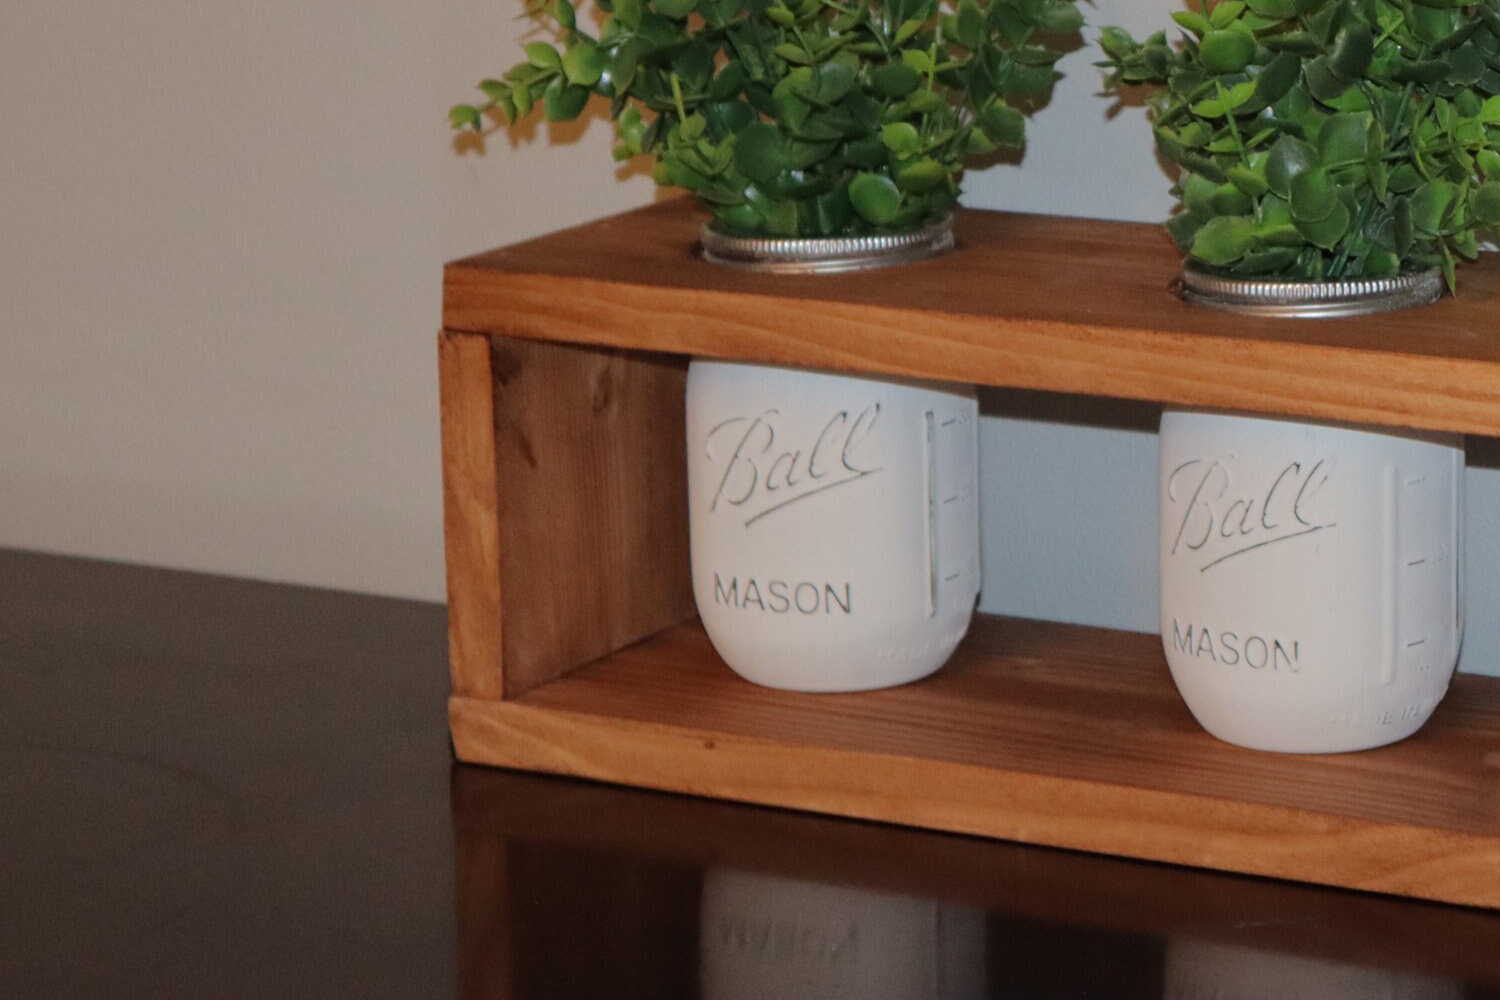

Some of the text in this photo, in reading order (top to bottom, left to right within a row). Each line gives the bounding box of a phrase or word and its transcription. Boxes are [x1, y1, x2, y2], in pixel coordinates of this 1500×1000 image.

[705, 401, 885, 514] Ball
[1167, 452, 1338, 557] Ball
[712, 571, 853, 616] MASON
[1171, 617, 1300, 674] MASON
